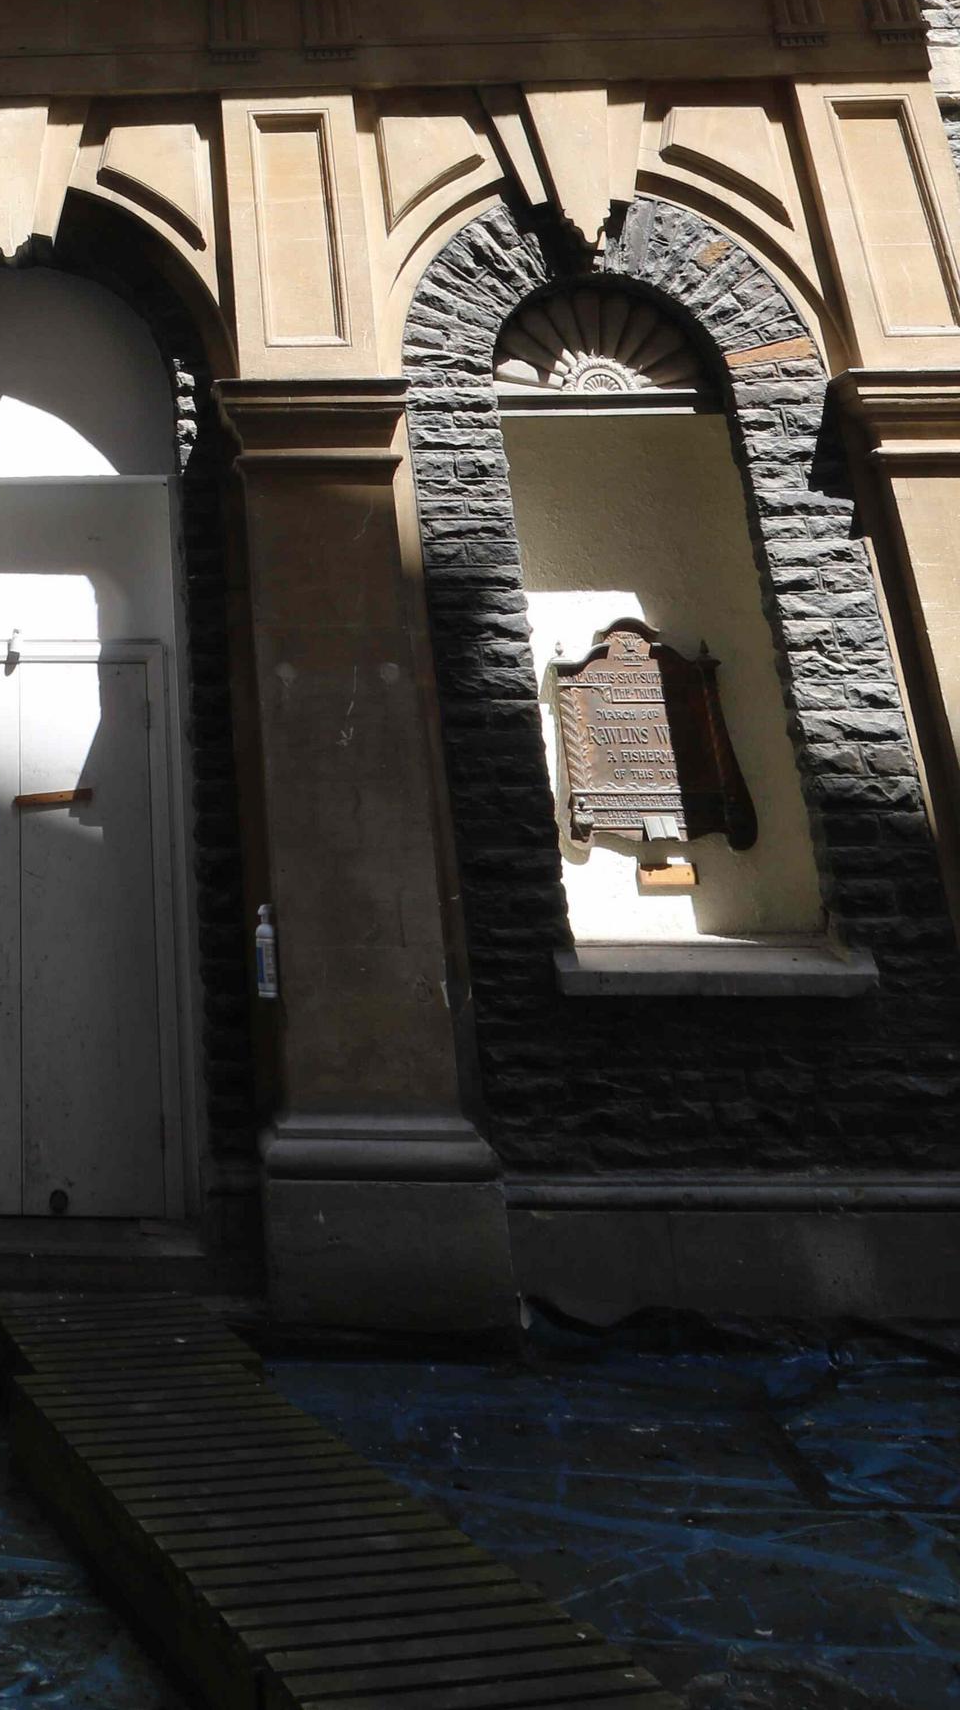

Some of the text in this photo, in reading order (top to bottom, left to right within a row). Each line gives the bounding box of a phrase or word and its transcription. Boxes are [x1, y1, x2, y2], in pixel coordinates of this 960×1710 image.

[596, 709, 636, 720] MARCH
[586, 724, 649, 746] RAWLINS
[607, 750, 617, 762] A
[614, 769, 626, 779] OF
[630, 769, 655, 779] THIS
